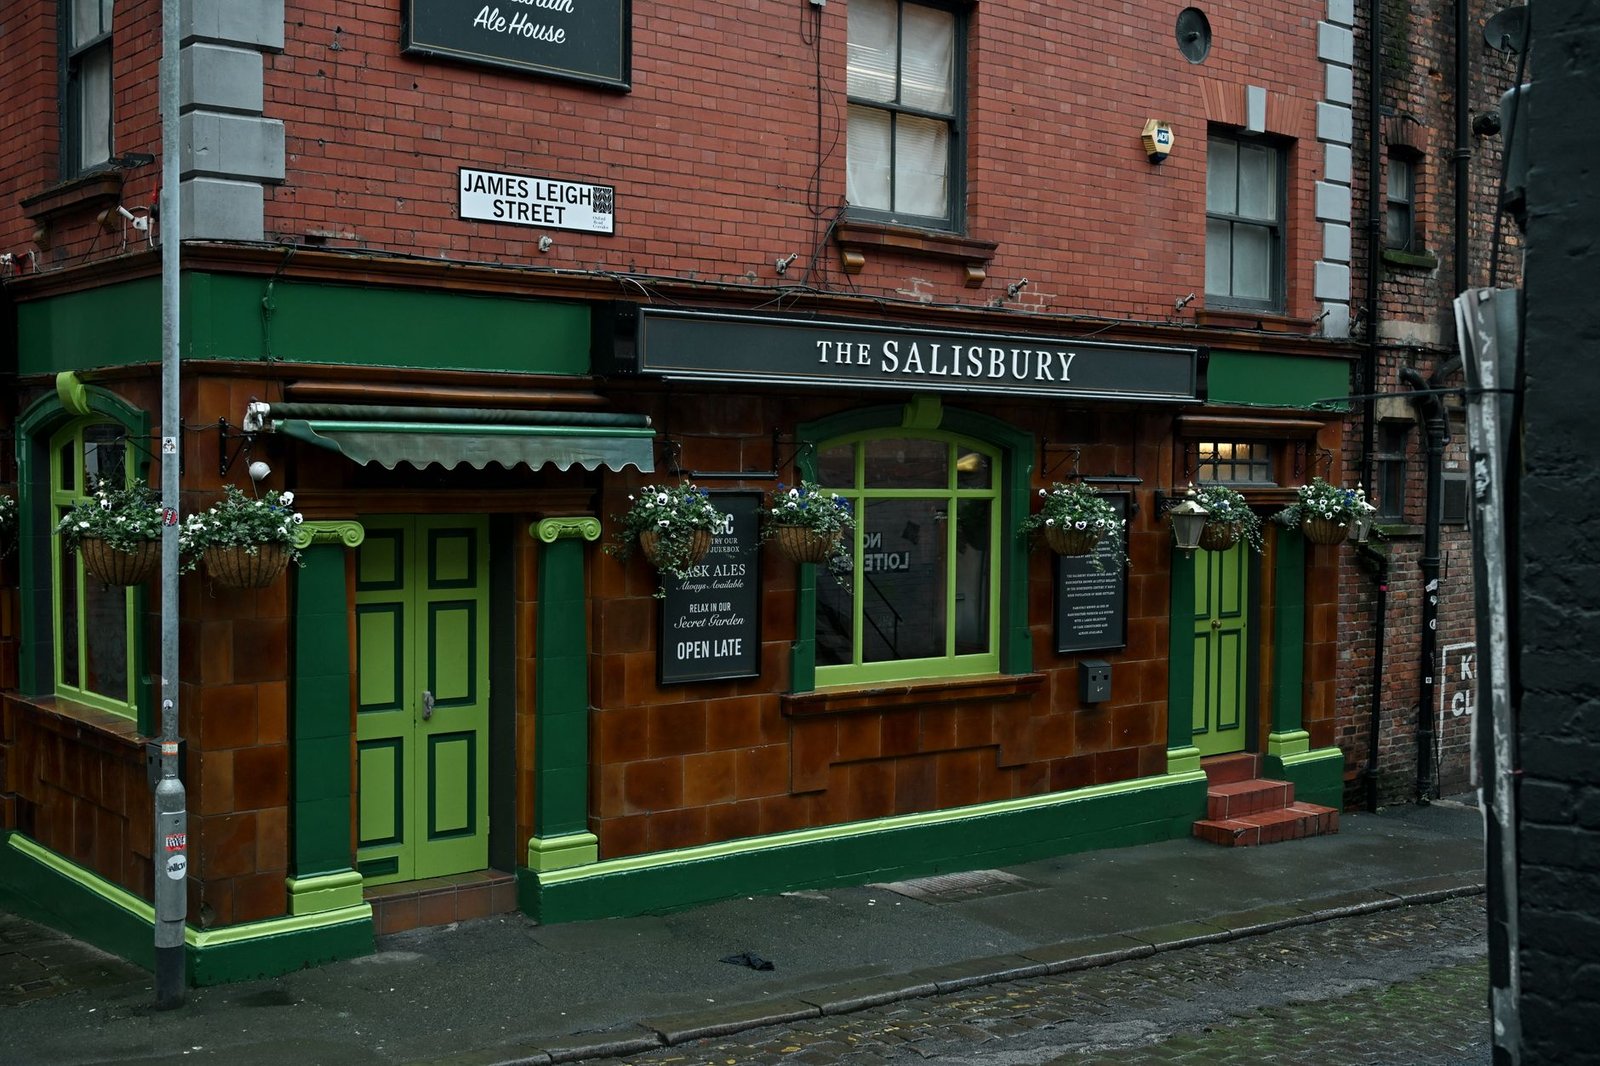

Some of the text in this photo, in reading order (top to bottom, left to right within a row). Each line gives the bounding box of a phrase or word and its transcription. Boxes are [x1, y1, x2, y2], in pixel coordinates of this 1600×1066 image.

[474, 5, 506, 32] Ale
[508, 11, 566, 44] House
[463, 173, 592, 206] JAMES LEIGH
[493, 199, 566, 225] STREET
[816, 340, 1076, 381] THE SALISBURY
[724, 537, 738, 545] OUR
[681, 563, 746, 578] ASK ALES
[675, 579, 745, 593] Always Available
[689, 602, 731, 613] RELAX IN OUR
[673, 613, 745, 629] Secret Garden
[677, 638, 742, 660] OPEN LATE
